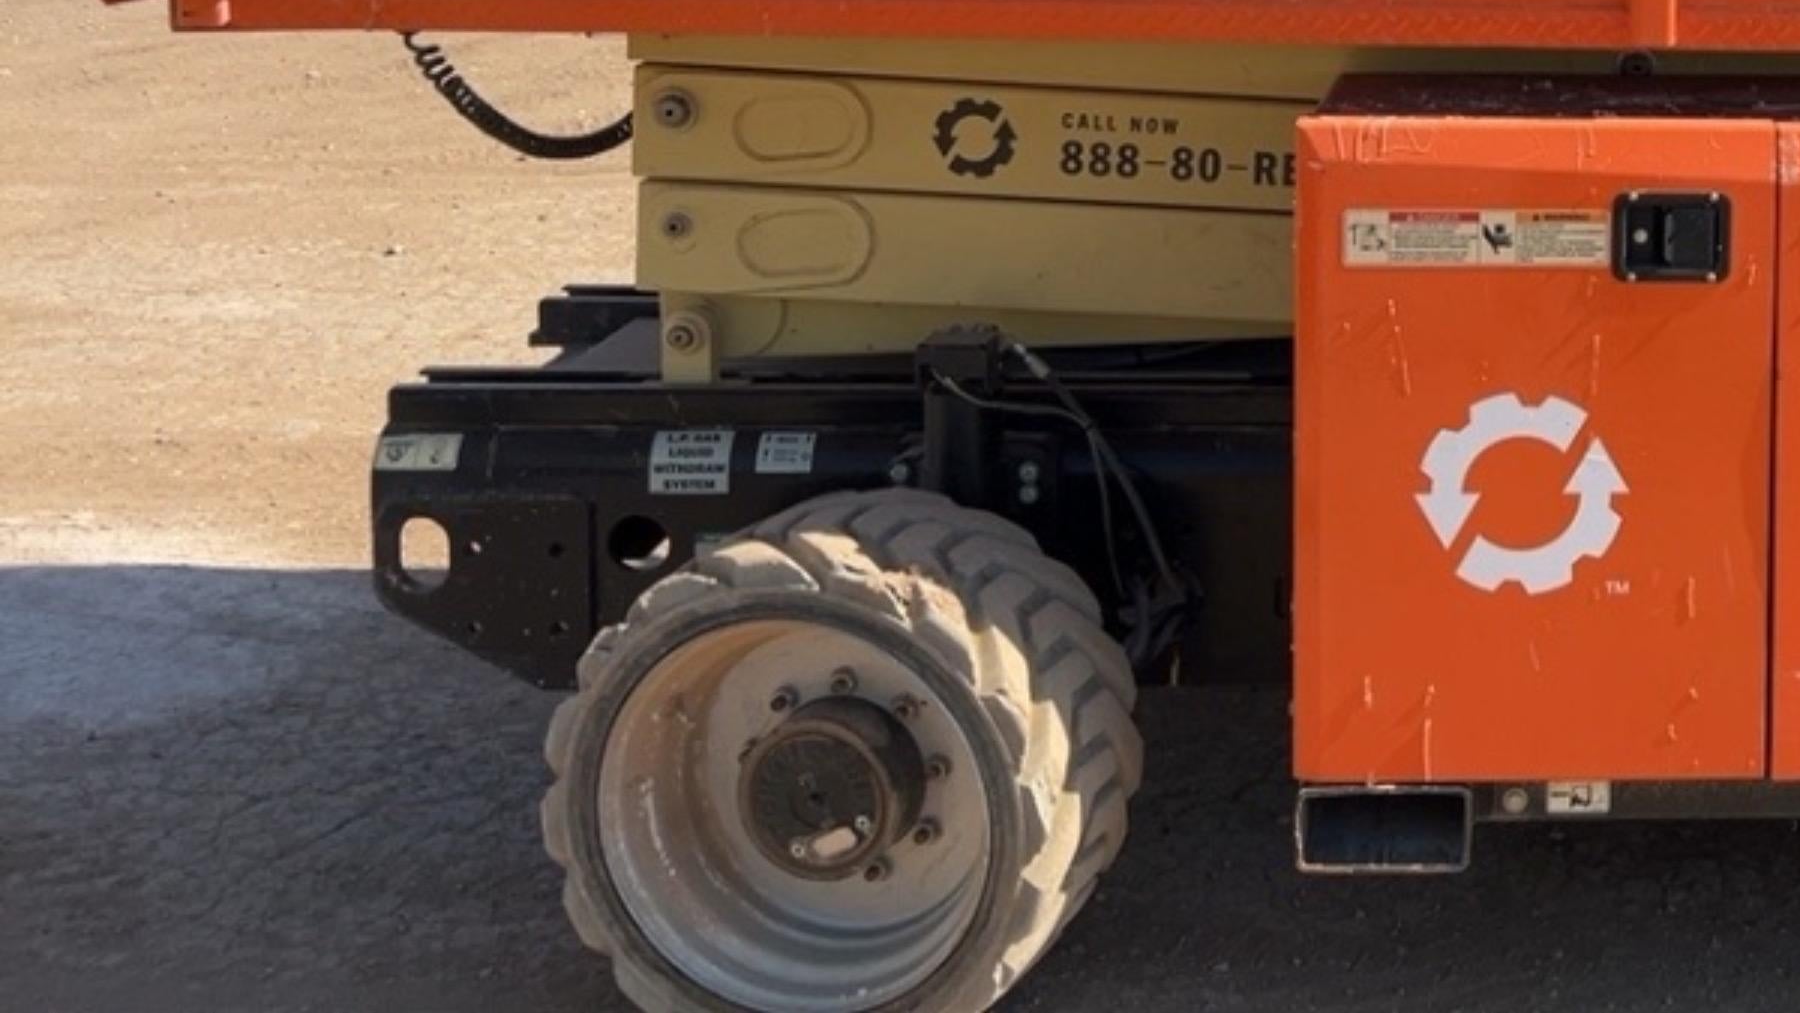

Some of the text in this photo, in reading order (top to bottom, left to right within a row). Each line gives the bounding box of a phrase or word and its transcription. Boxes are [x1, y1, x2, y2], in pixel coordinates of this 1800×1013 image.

[1060, 112, 1180, 136] CALL NOW
[1604, 580, 1630, 594] TM
